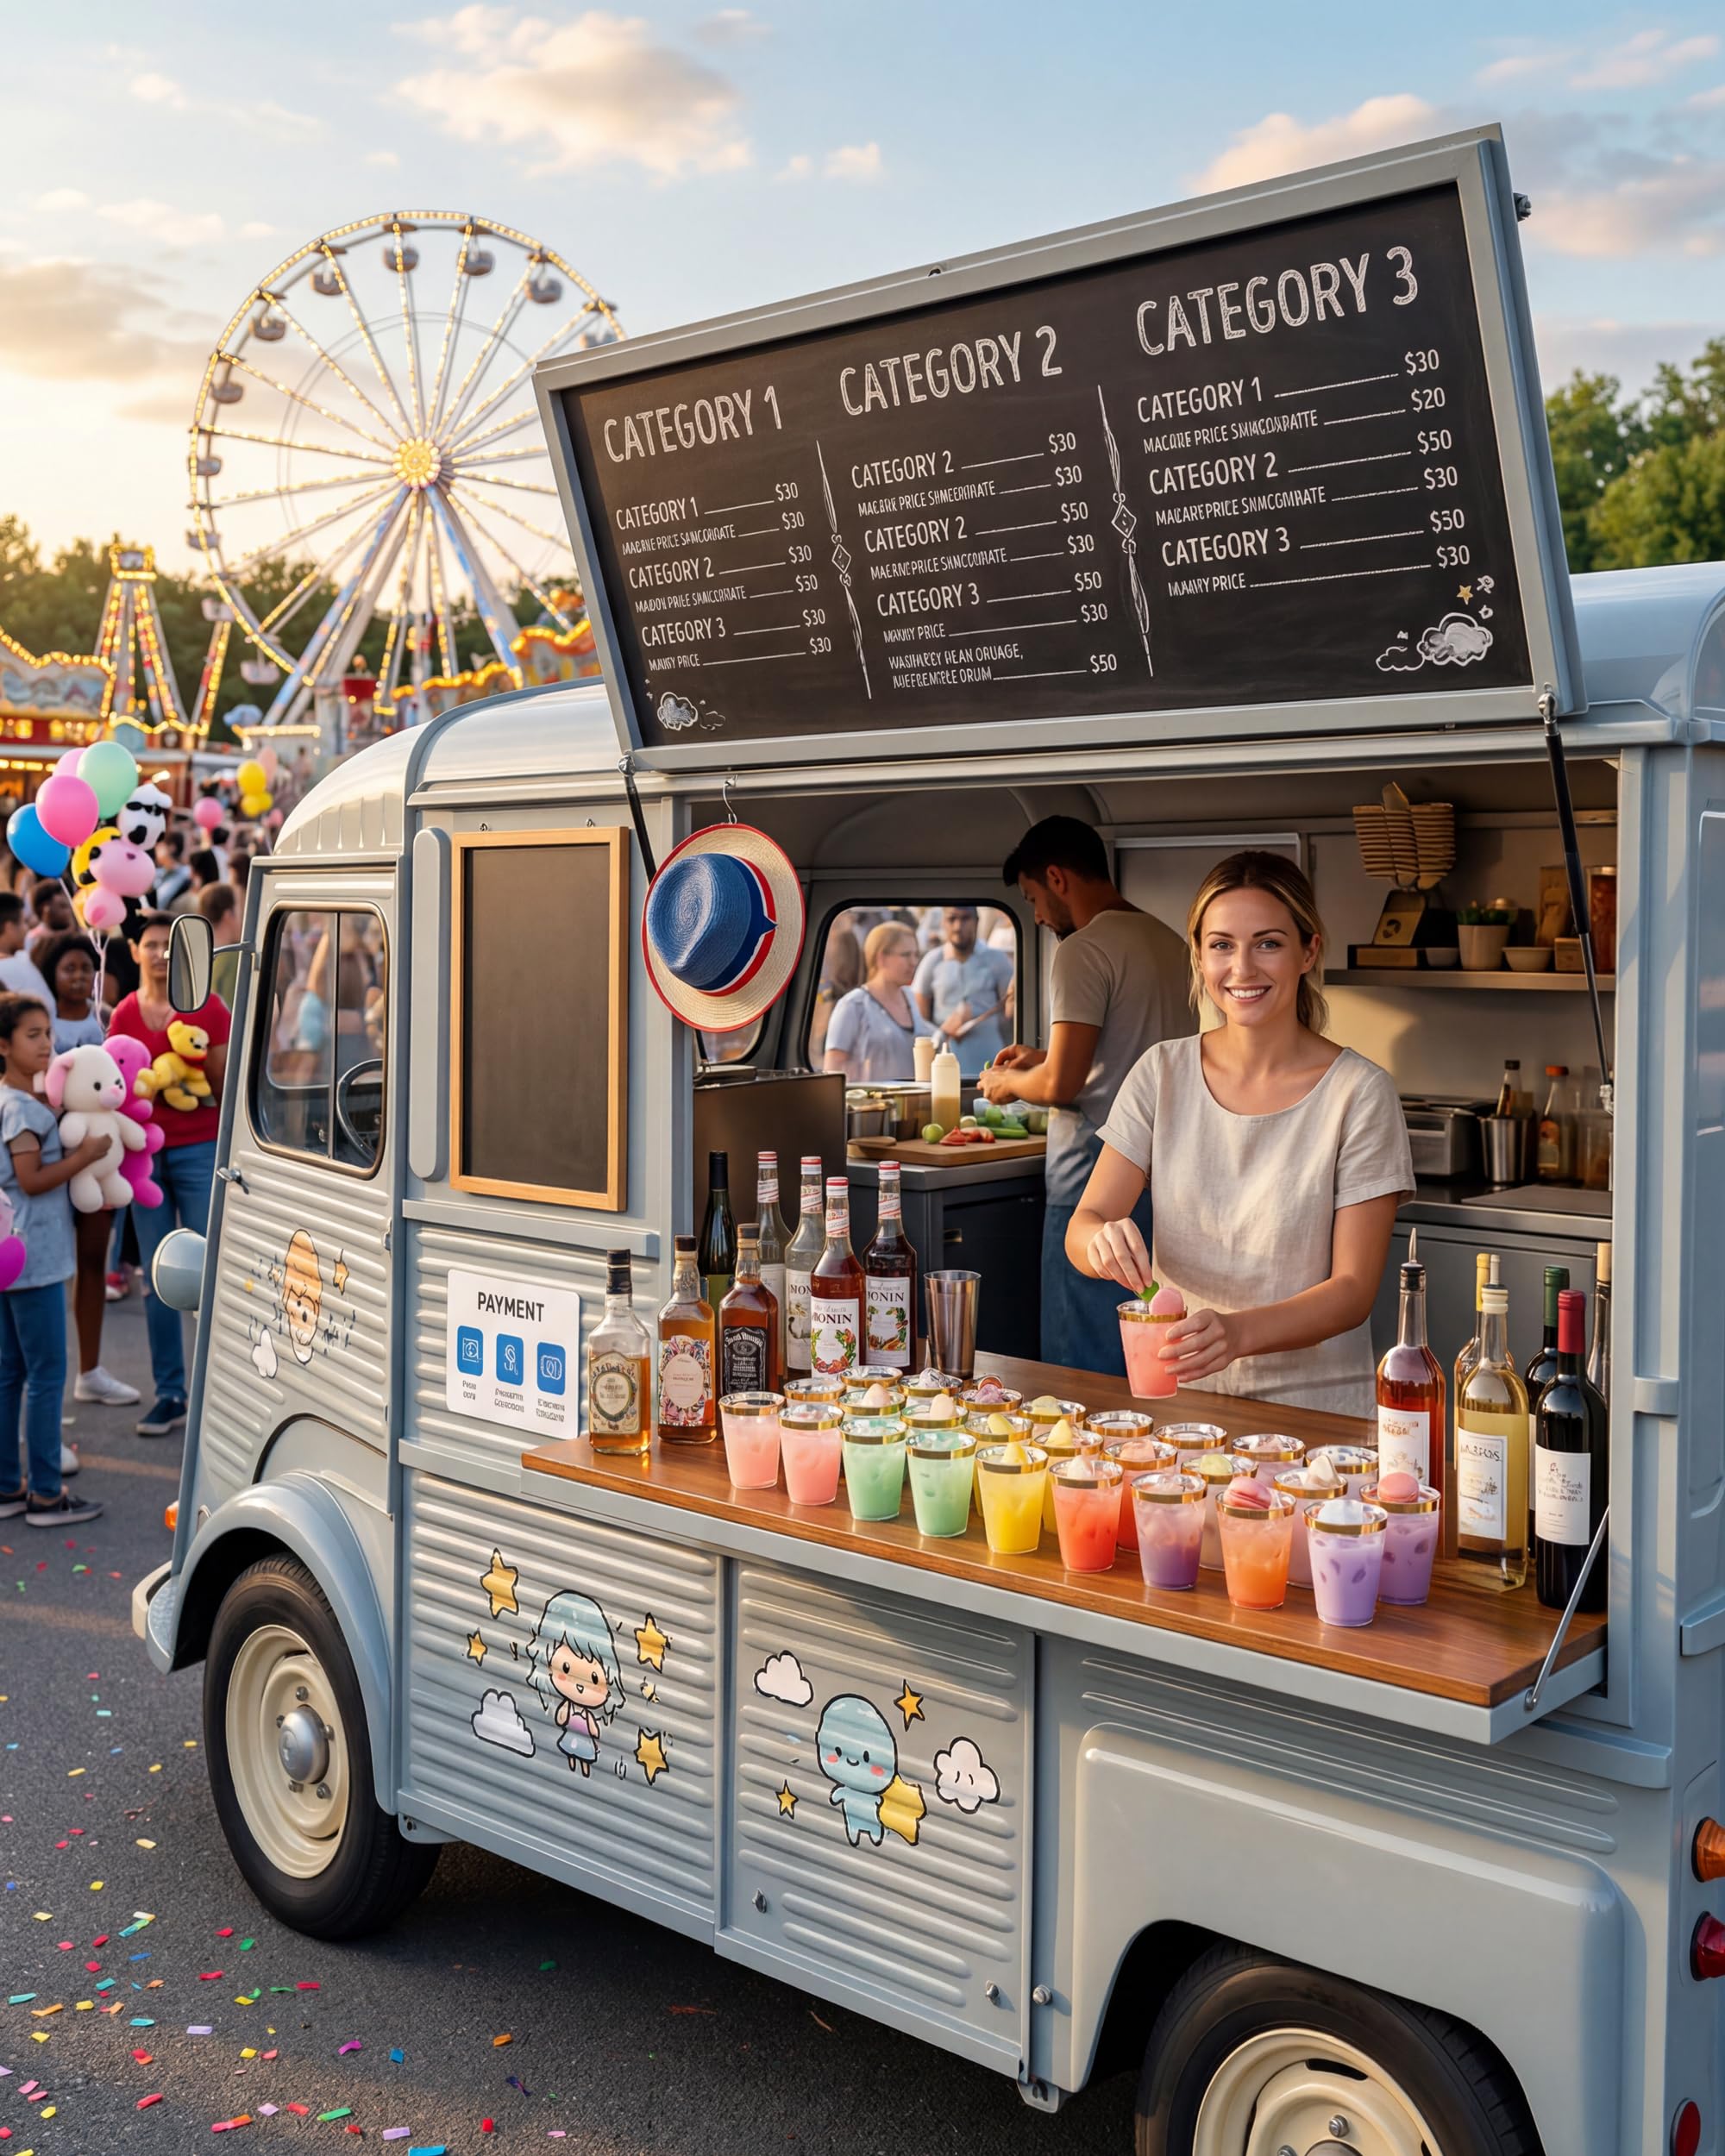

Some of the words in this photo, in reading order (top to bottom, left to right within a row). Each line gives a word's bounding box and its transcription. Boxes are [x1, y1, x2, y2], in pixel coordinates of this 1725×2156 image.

[1137, 254, 1369, 355] CATEGORY
[1387, 246, 1417, 305] 3
[840, 332, 1020, 415] CATEGORY
[1036, 326, 1062, 376] 2
[1138, 379, 1243, 423] CATEGORY
[1251, 377, 1261, 401] 1
[1405, 349, 1439, 375] $30
[605, 389, 753, 462] CATEGORY
[764, 385, 781, 429] 1
[1195, 425, 1229, 445] PRICE
[1411, 387, 1445, 412] $20
[852, 453, 935, 488] CATEGORY
[943, 450, 954, 473] 2
[1049, 432, 1076, 454] $30
[1150, 454, 1256, 494] CATEGORY
[1264, 452, 1278, 478] 2
[1418, 429, 1452, 454] $50
[617, 498, 686, 530] CATEGORY
[690, 497, 698, 517] 1
[775, 482, 798, 501] $30
[899, 492, 927, 510] PRICE
[1056, 466, 1082, 486] $30
[1207, 499, 1239, 518] PRICE
[1424, 467, 1457, 490] $30
[656, 534, 680, 549] PRICE
[782, 511, 804, 530] $30
[865, 518, 949, 552] CATEGORY
[956, 517, 967, 539] 2
[1062, 502, 1088, 523] $50
[1163, 529, 1268, 566] CATEGORY
[1276, 527, 1289, 552] 3
[630, 558, 699, 588] CATEGORY
[704, 557, 714, 578] 2
[788, 545, 812, 563] $30
[911, 558, 940, 575] PRICE
[1068, 535, 1094, 555] $30
[1213, 573, 1245, 591] PRICE
[1437, 545, 1470, 568] $30
[877, 584, 962, 616] CATEGORY
[969, 583, 979, 605] 3
[1075, 572, 1101, 592] $50
[642, 618, 711, 646] CATEGORY
[716, 617, 725, 637] 3
[803, 609, 825, 627] $30
[918, 624, 945, 639] PRICE
[1082, 604, 1107, 623] $30
[677, 654, 700, 667] PRICE
[810, 637, 831, 655] $30
[1090, 654, 1117, 674] $50
[478, 1292, 544, 1322] PAYMENT
